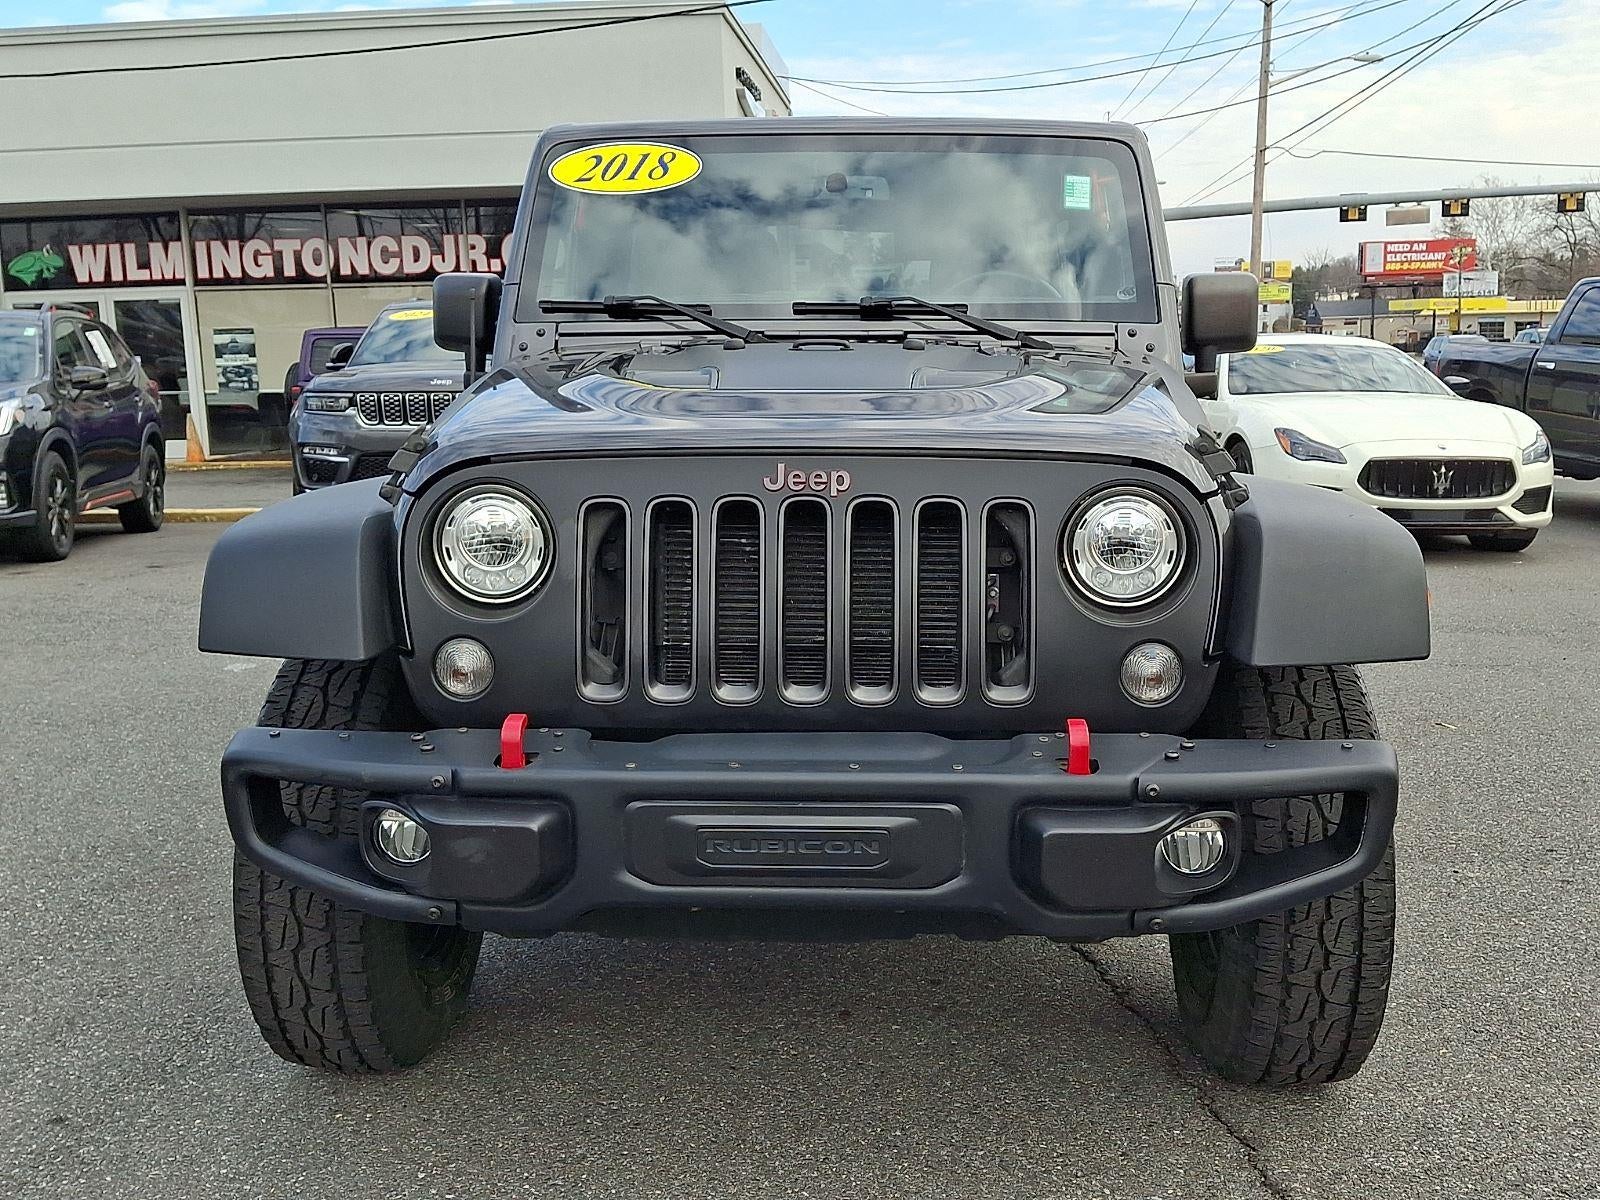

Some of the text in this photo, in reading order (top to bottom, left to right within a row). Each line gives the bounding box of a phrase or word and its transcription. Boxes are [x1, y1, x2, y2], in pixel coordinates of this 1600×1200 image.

[573, 152, 677, 182] 2018
[1387, 243, 1426, 252] NEED AN
[1386, 252, 1447, 261] ELECTRICIAN?
[763, 463, 851, 497] Jeep
[706, 839, 880, 854] RUBICON
